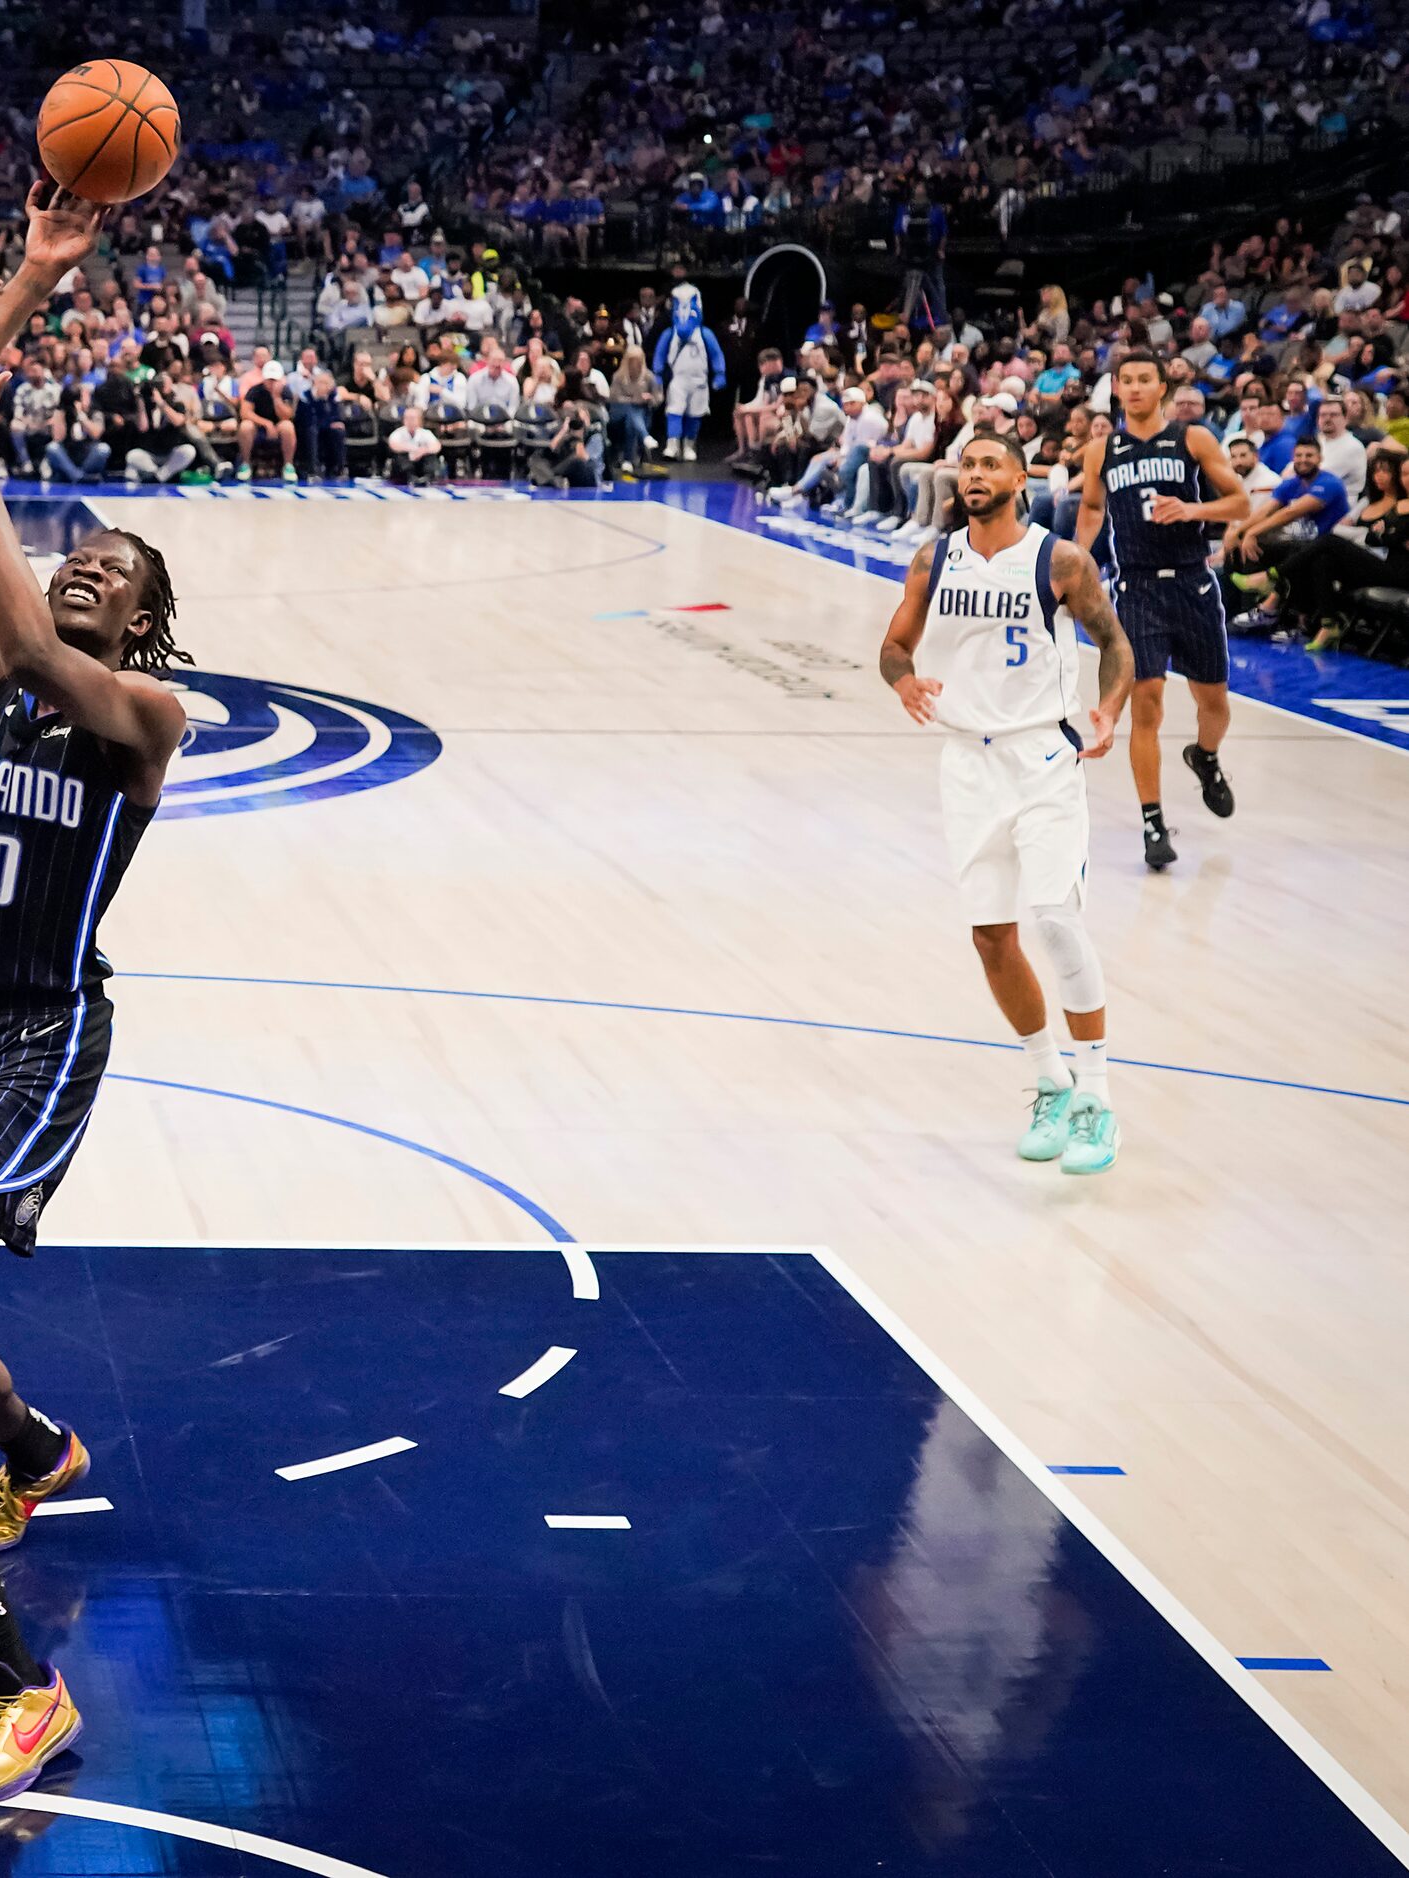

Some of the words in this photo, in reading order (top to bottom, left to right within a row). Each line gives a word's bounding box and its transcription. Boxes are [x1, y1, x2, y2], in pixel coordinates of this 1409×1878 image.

[1106, 457, 1185, 493] ORLANDO
[939, 587, 1031, 620] DALLAS
[1005, 625, 1028, 668] 5
